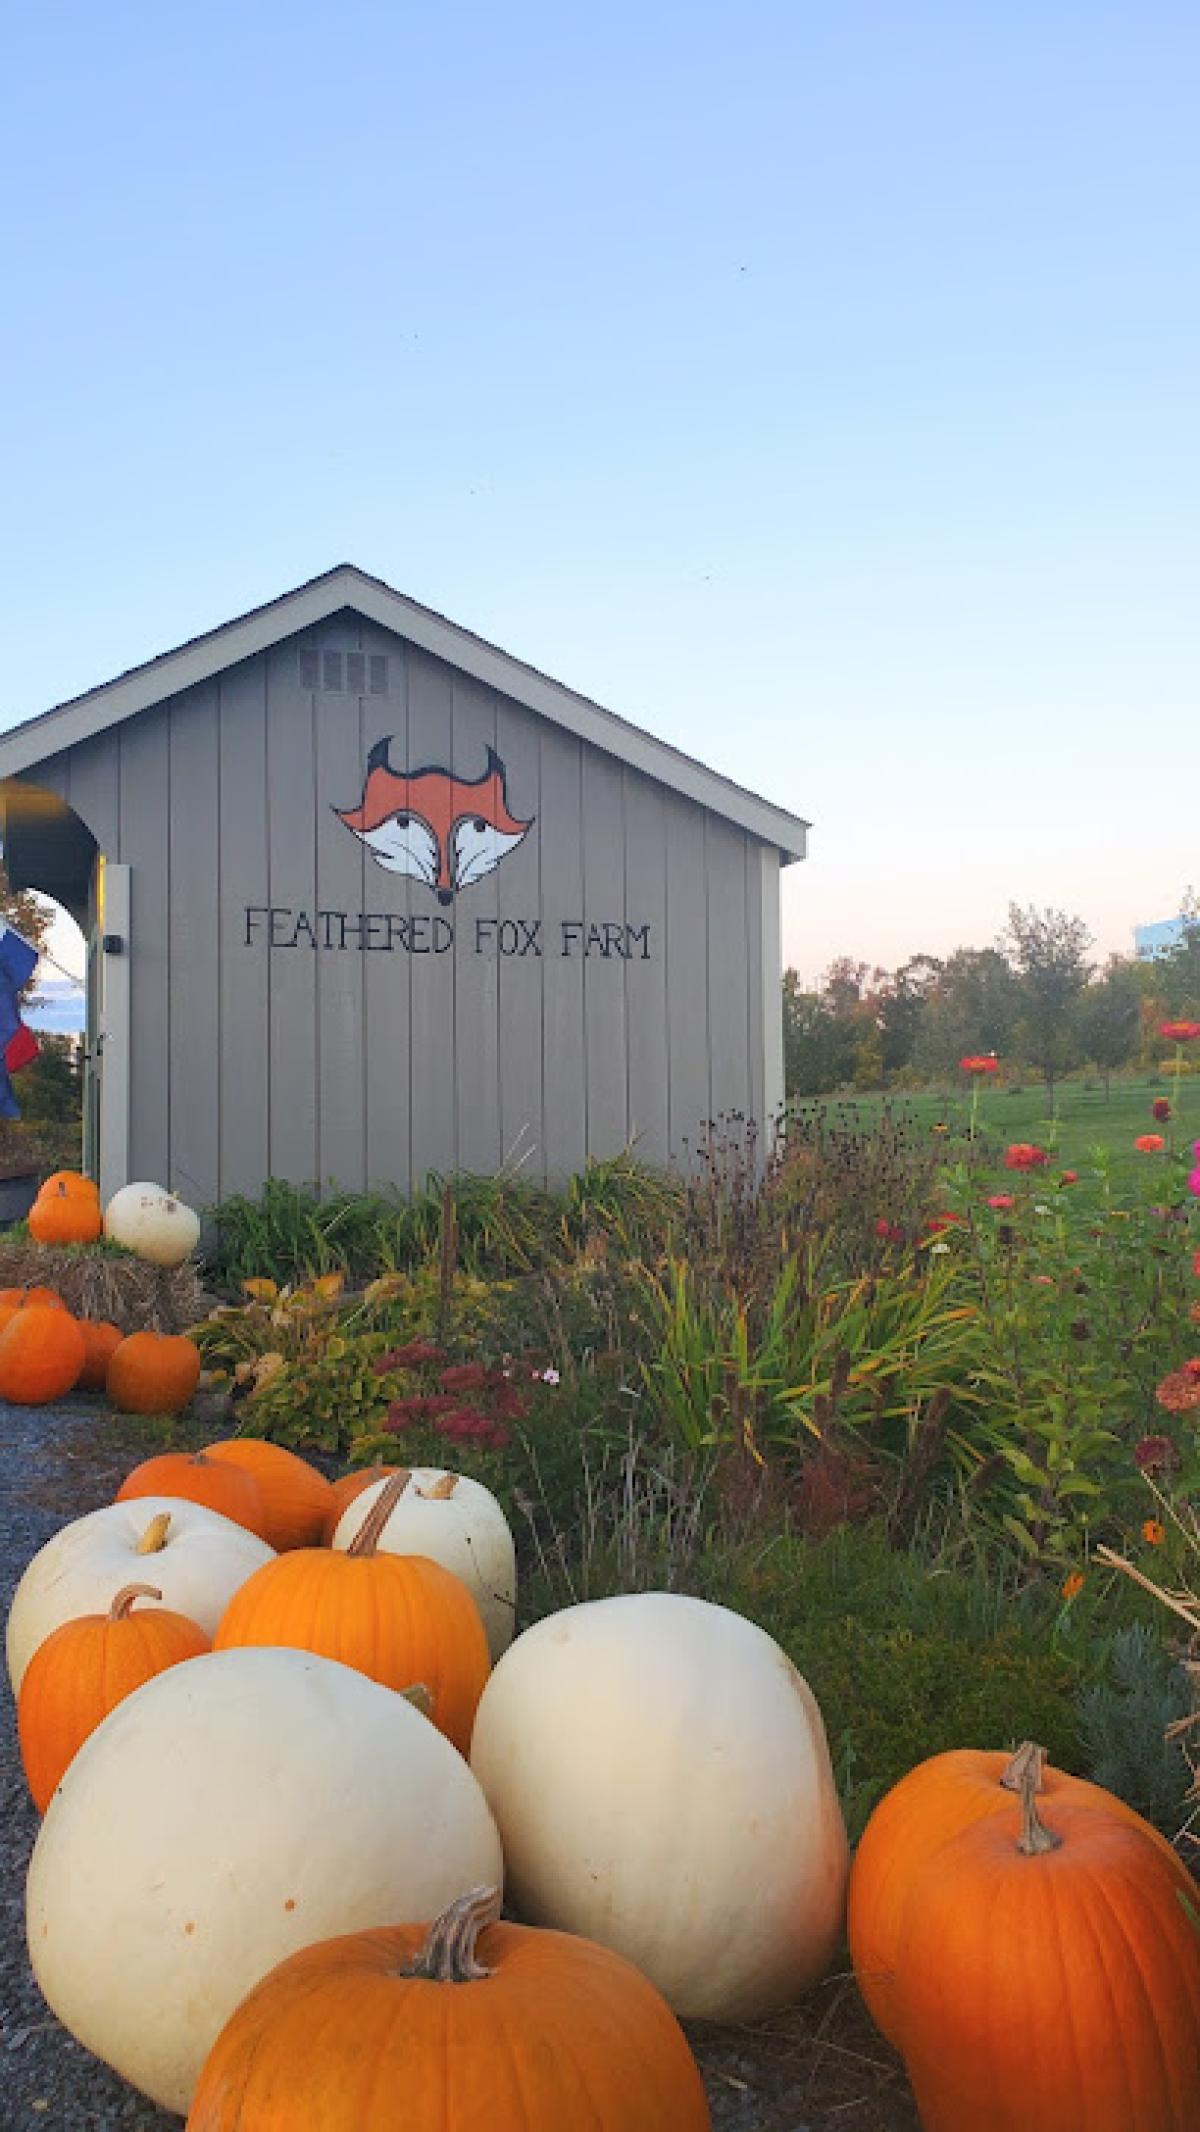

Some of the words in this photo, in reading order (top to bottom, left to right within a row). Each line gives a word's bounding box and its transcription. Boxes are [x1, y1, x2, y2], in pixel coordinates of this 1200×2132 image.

[244, 906, 454, 953] FEATHERED
[475, 917, 542, 956] FOX
[561, 921, 651, 959] FARM
